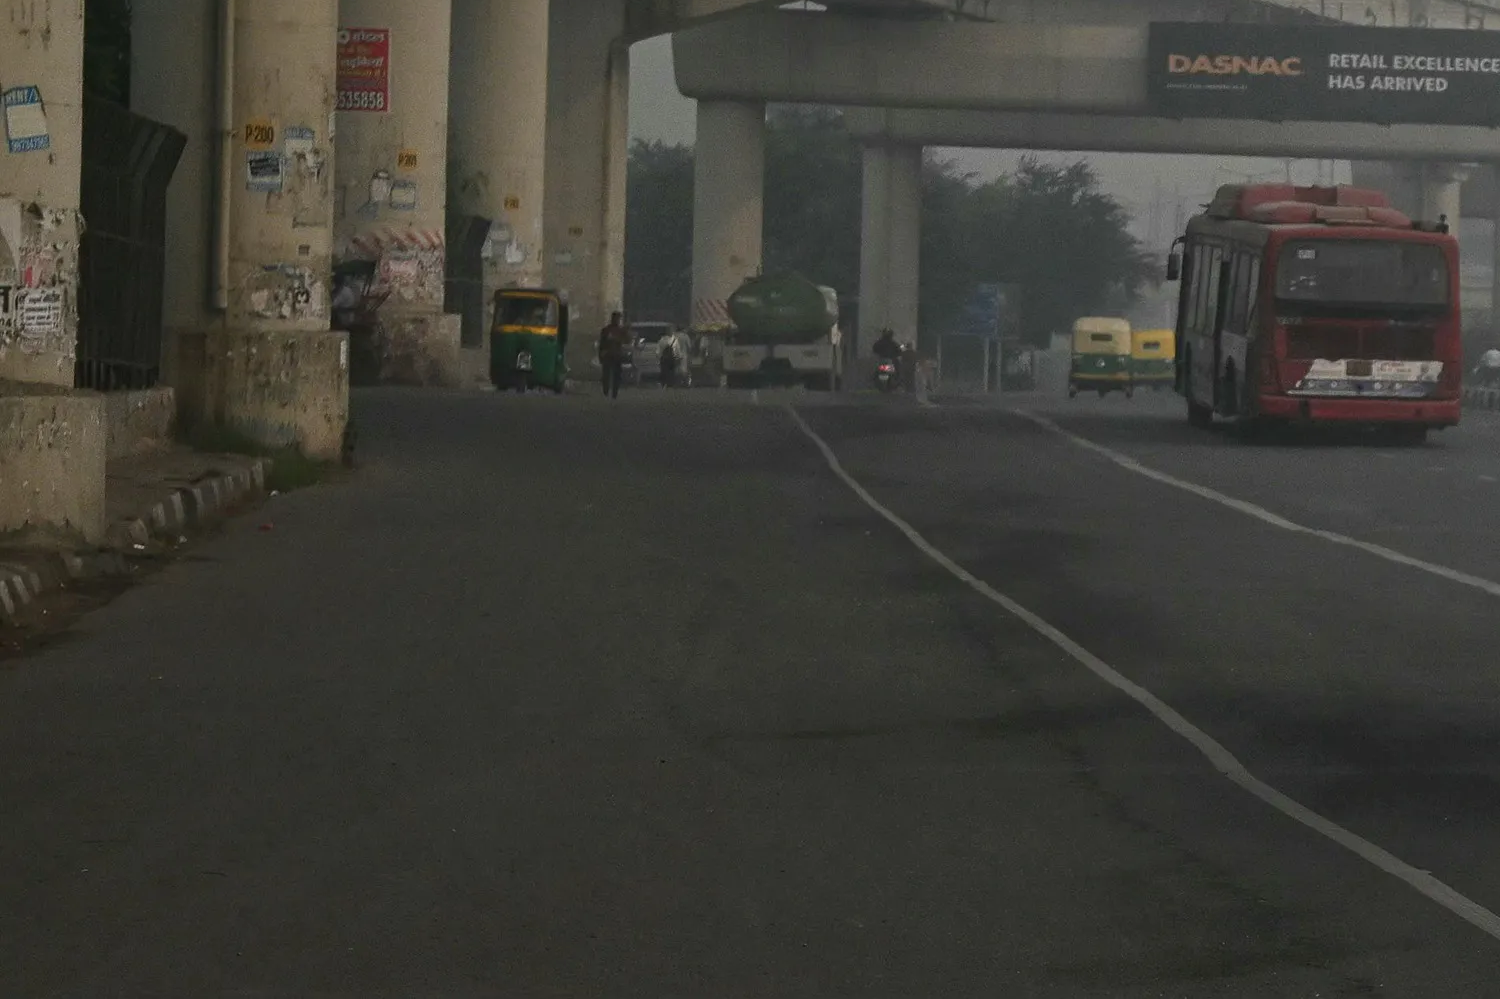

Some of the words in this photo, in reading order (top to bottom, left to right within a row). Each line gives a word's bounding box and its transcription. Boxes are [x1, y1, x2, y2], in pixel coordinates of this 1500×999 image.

[1167, 54, 1302, 76] DASNAC
[1328, 53, 1387, 70] RETAIL
[1393, 54, 1500, 73] EXCELLENCE
[1328, 74, 1366, 90] HAS
[1369, 75, 1449, 92] ARRIVED
